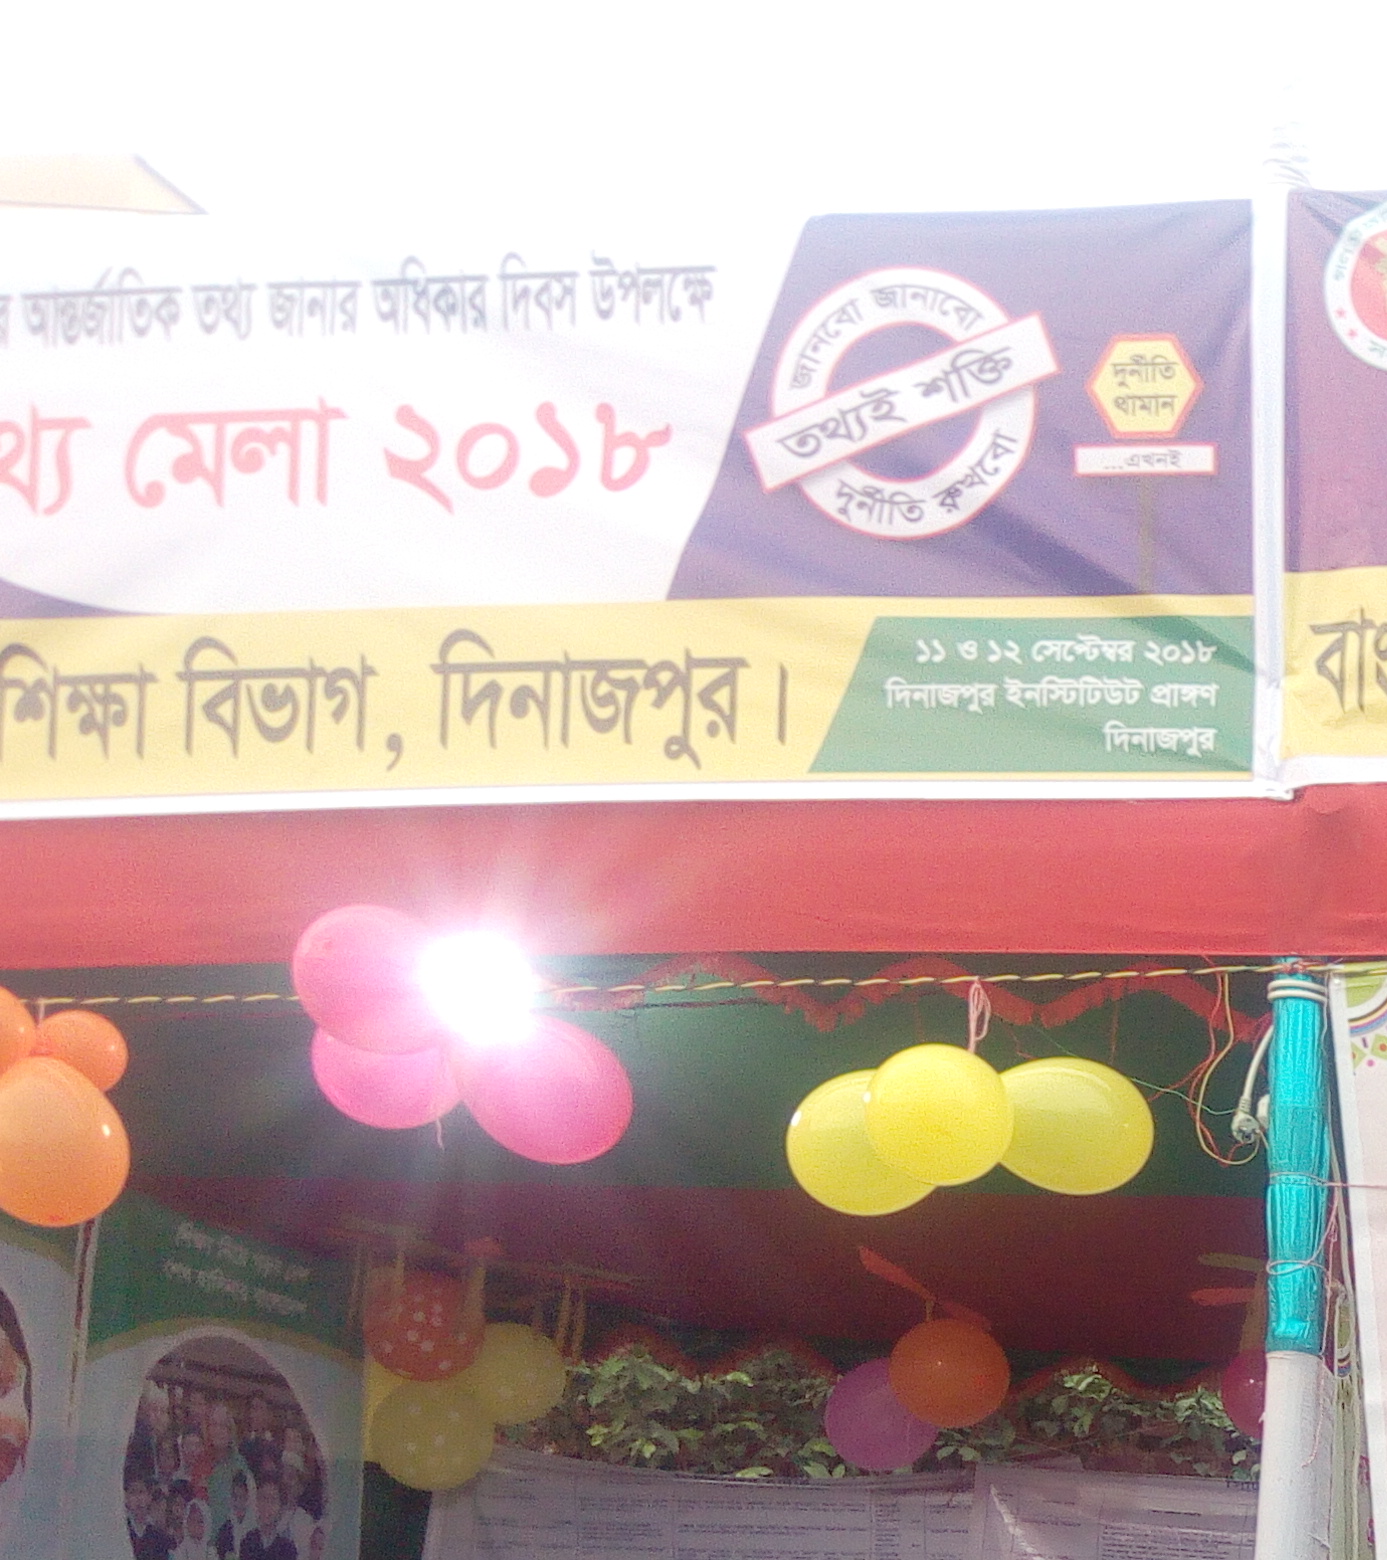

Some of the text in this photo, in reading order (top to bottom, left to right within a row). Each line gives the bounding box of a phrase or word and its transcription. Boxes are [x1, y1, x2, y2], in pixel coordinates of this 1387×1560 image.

[193, 282, 255, 341] তথ্য
[267, 275, 361, 337] জানার
[371, 253, 489, 336] অধিকার
[499, 251, 579, 332] দিবস
[589, 251, 717, 324] উপলক্ষে
[915, 344, 1014, 403] শক্তি
[124, 396, 673, 514] মেলা ২০১৮
[916, 634, 1217, 665] ১১ ও ১২ সেপ্টেম্বর ২০১৮
[176, 635, 401, 770] বিভাগ,
[884, 678, 996, 714] দিনাজপুর
[1150, 680, 1219, 709] প্রাঙ্গণ
[1104, 719, 1218, 758] দিনাজপুর
